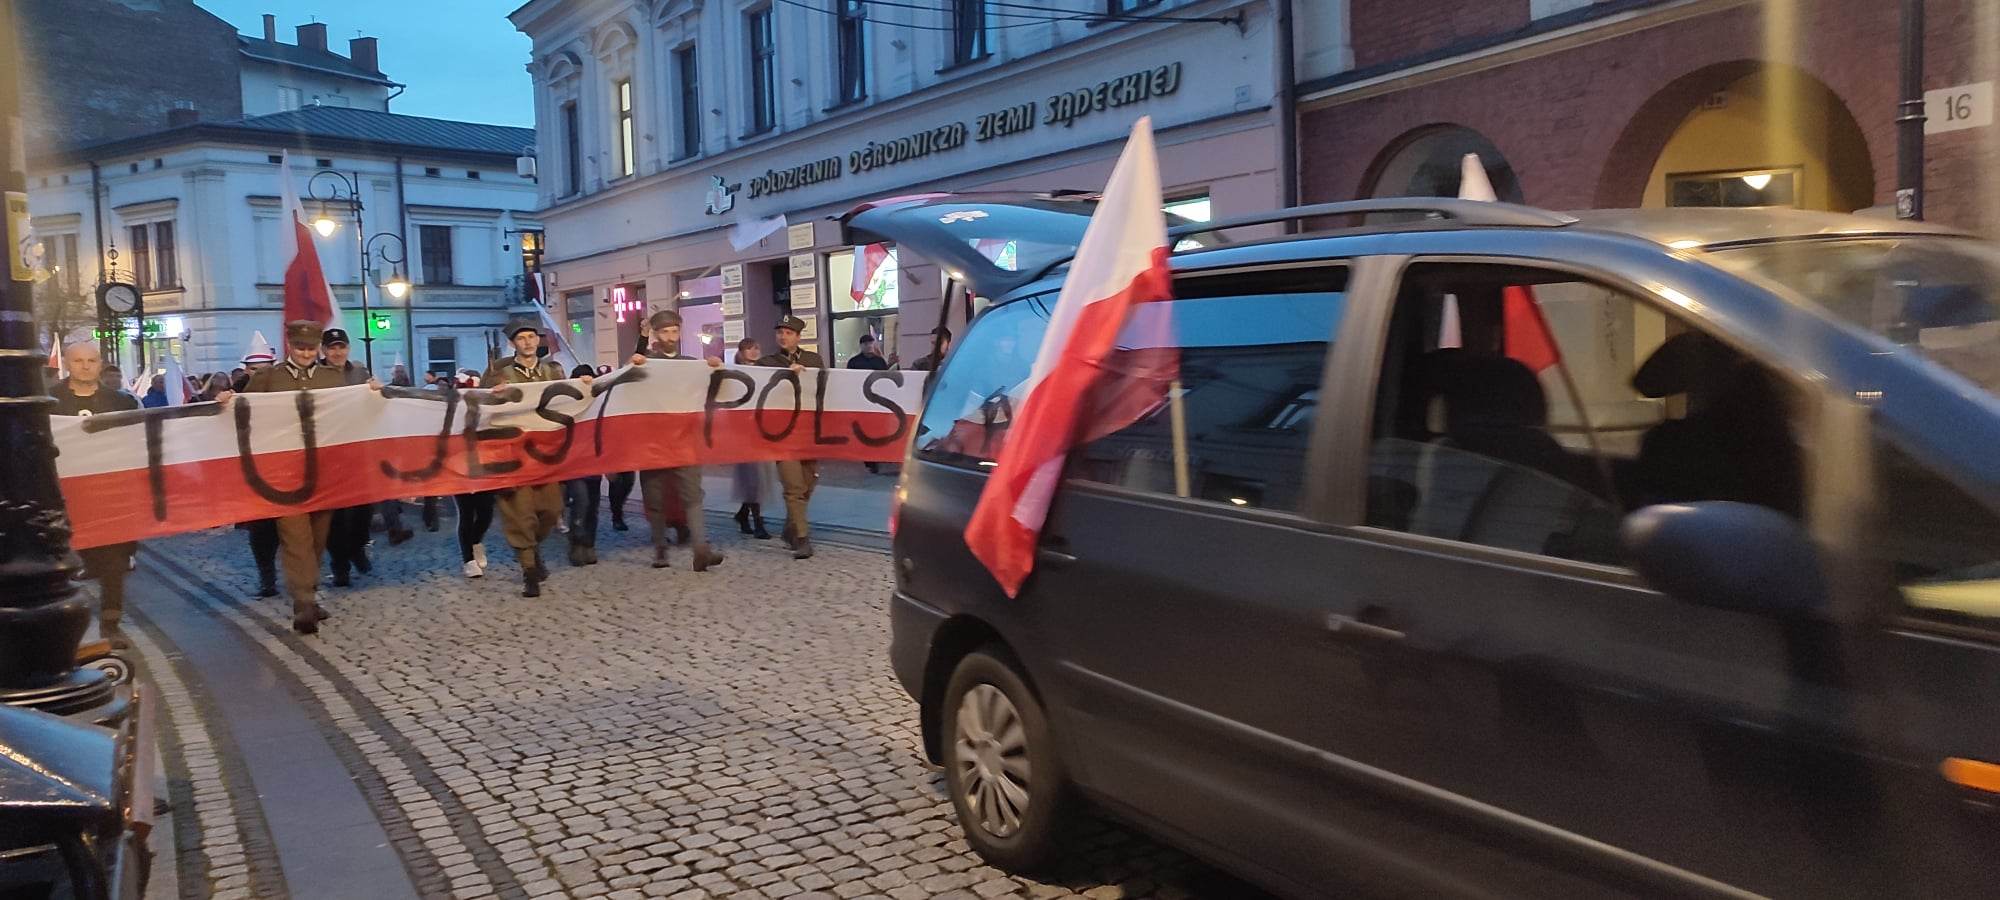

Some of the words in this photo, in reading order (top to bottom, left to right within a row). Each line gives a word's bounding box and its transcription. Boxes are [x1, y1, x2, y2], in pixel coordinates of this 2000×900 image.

[976, 102, 1036, 141] ZIEMI
[1043, 61, 1182, 128] SĄDECKIEJ
[1945, 93, 1972, 121] 16
[82, 388, 318, 522] TU
[379, 367, 648, 482] JEST
